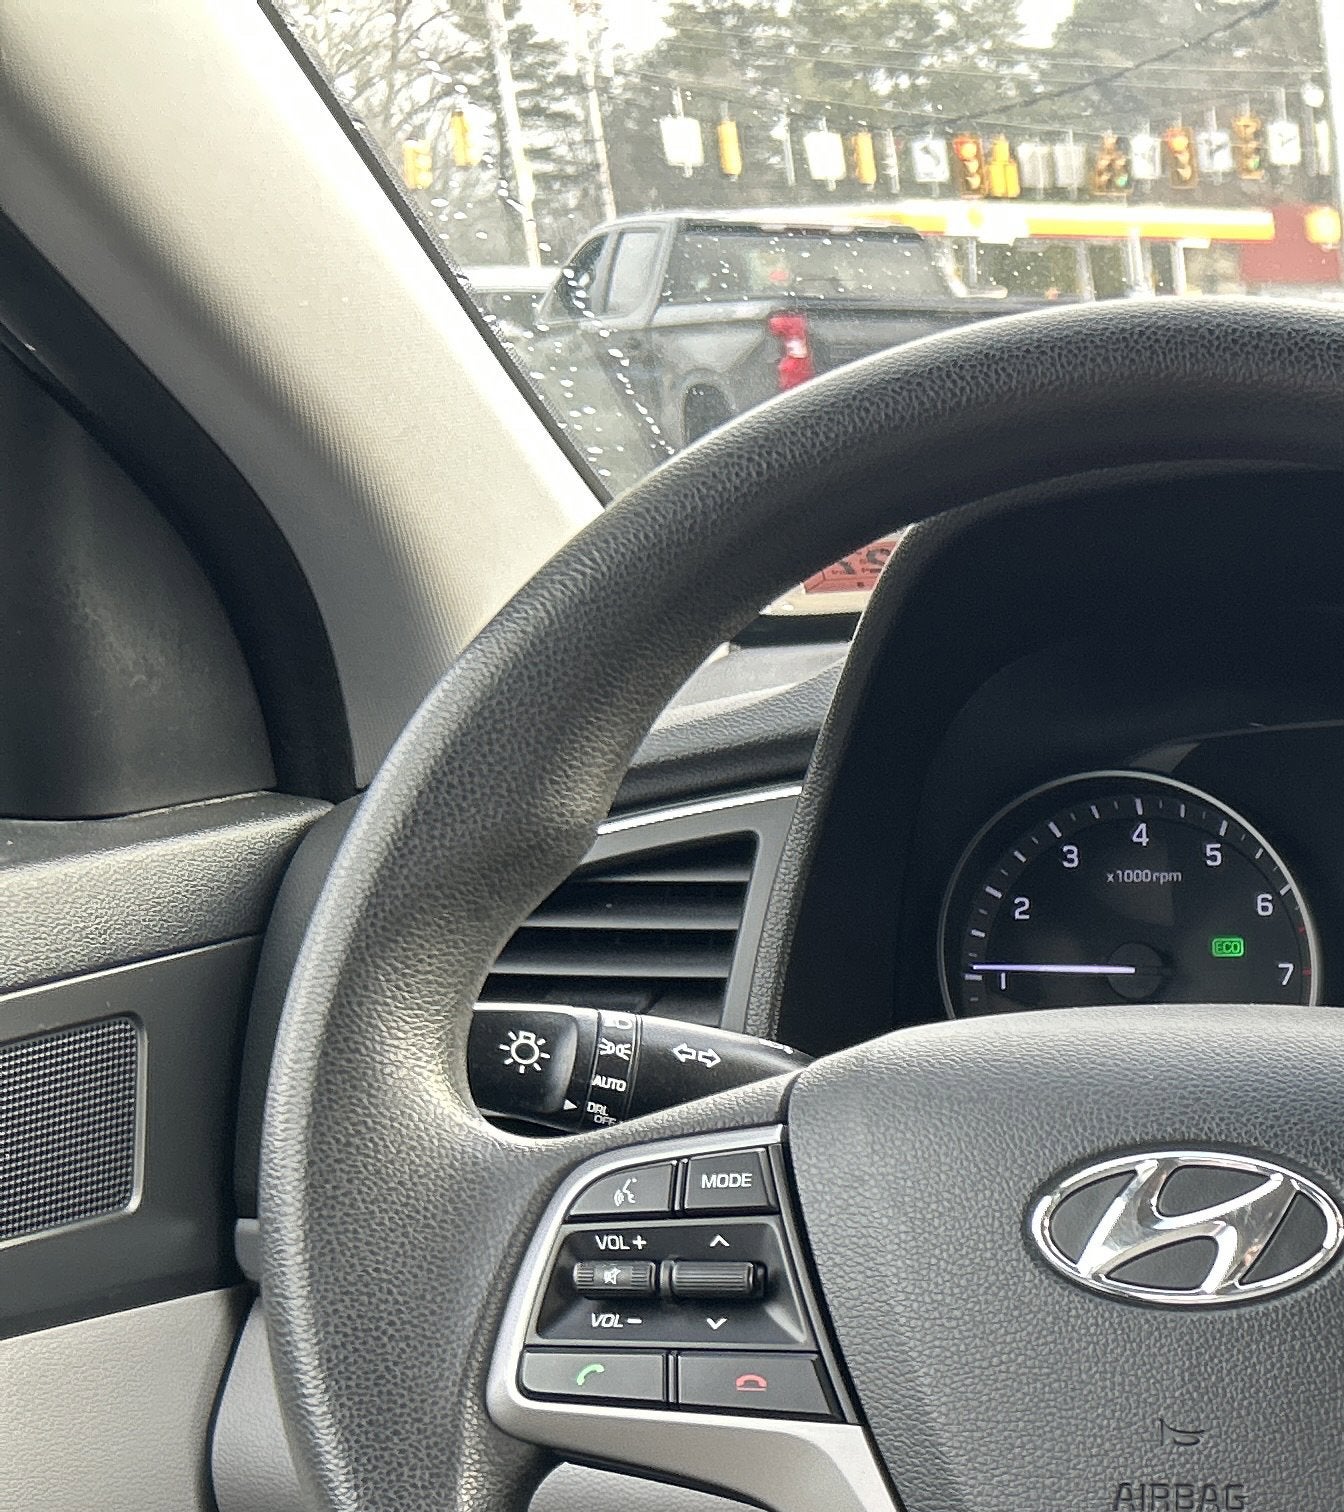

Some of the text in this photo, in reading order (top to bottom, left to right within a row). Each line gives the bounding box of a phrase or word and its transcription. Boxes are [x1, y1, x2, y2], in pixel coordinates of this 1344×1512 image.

[1132, 822, 1150, 847] 4
[1062, 844, 1079, 868] 3
[1205, 843, 1222, 866] 5
[1014, 897, 1030, 920] 2
[1256, 893, 1274, 917] 6
[1278, 963, 1294, 986] 7
[591, 1074, 627, 1092] AUTO
[586, 1101, 609, 1117] DRL
[701, 1172, 753, 1189] MODE
[1111, 1481, 1248, 1512] AIRBAG
